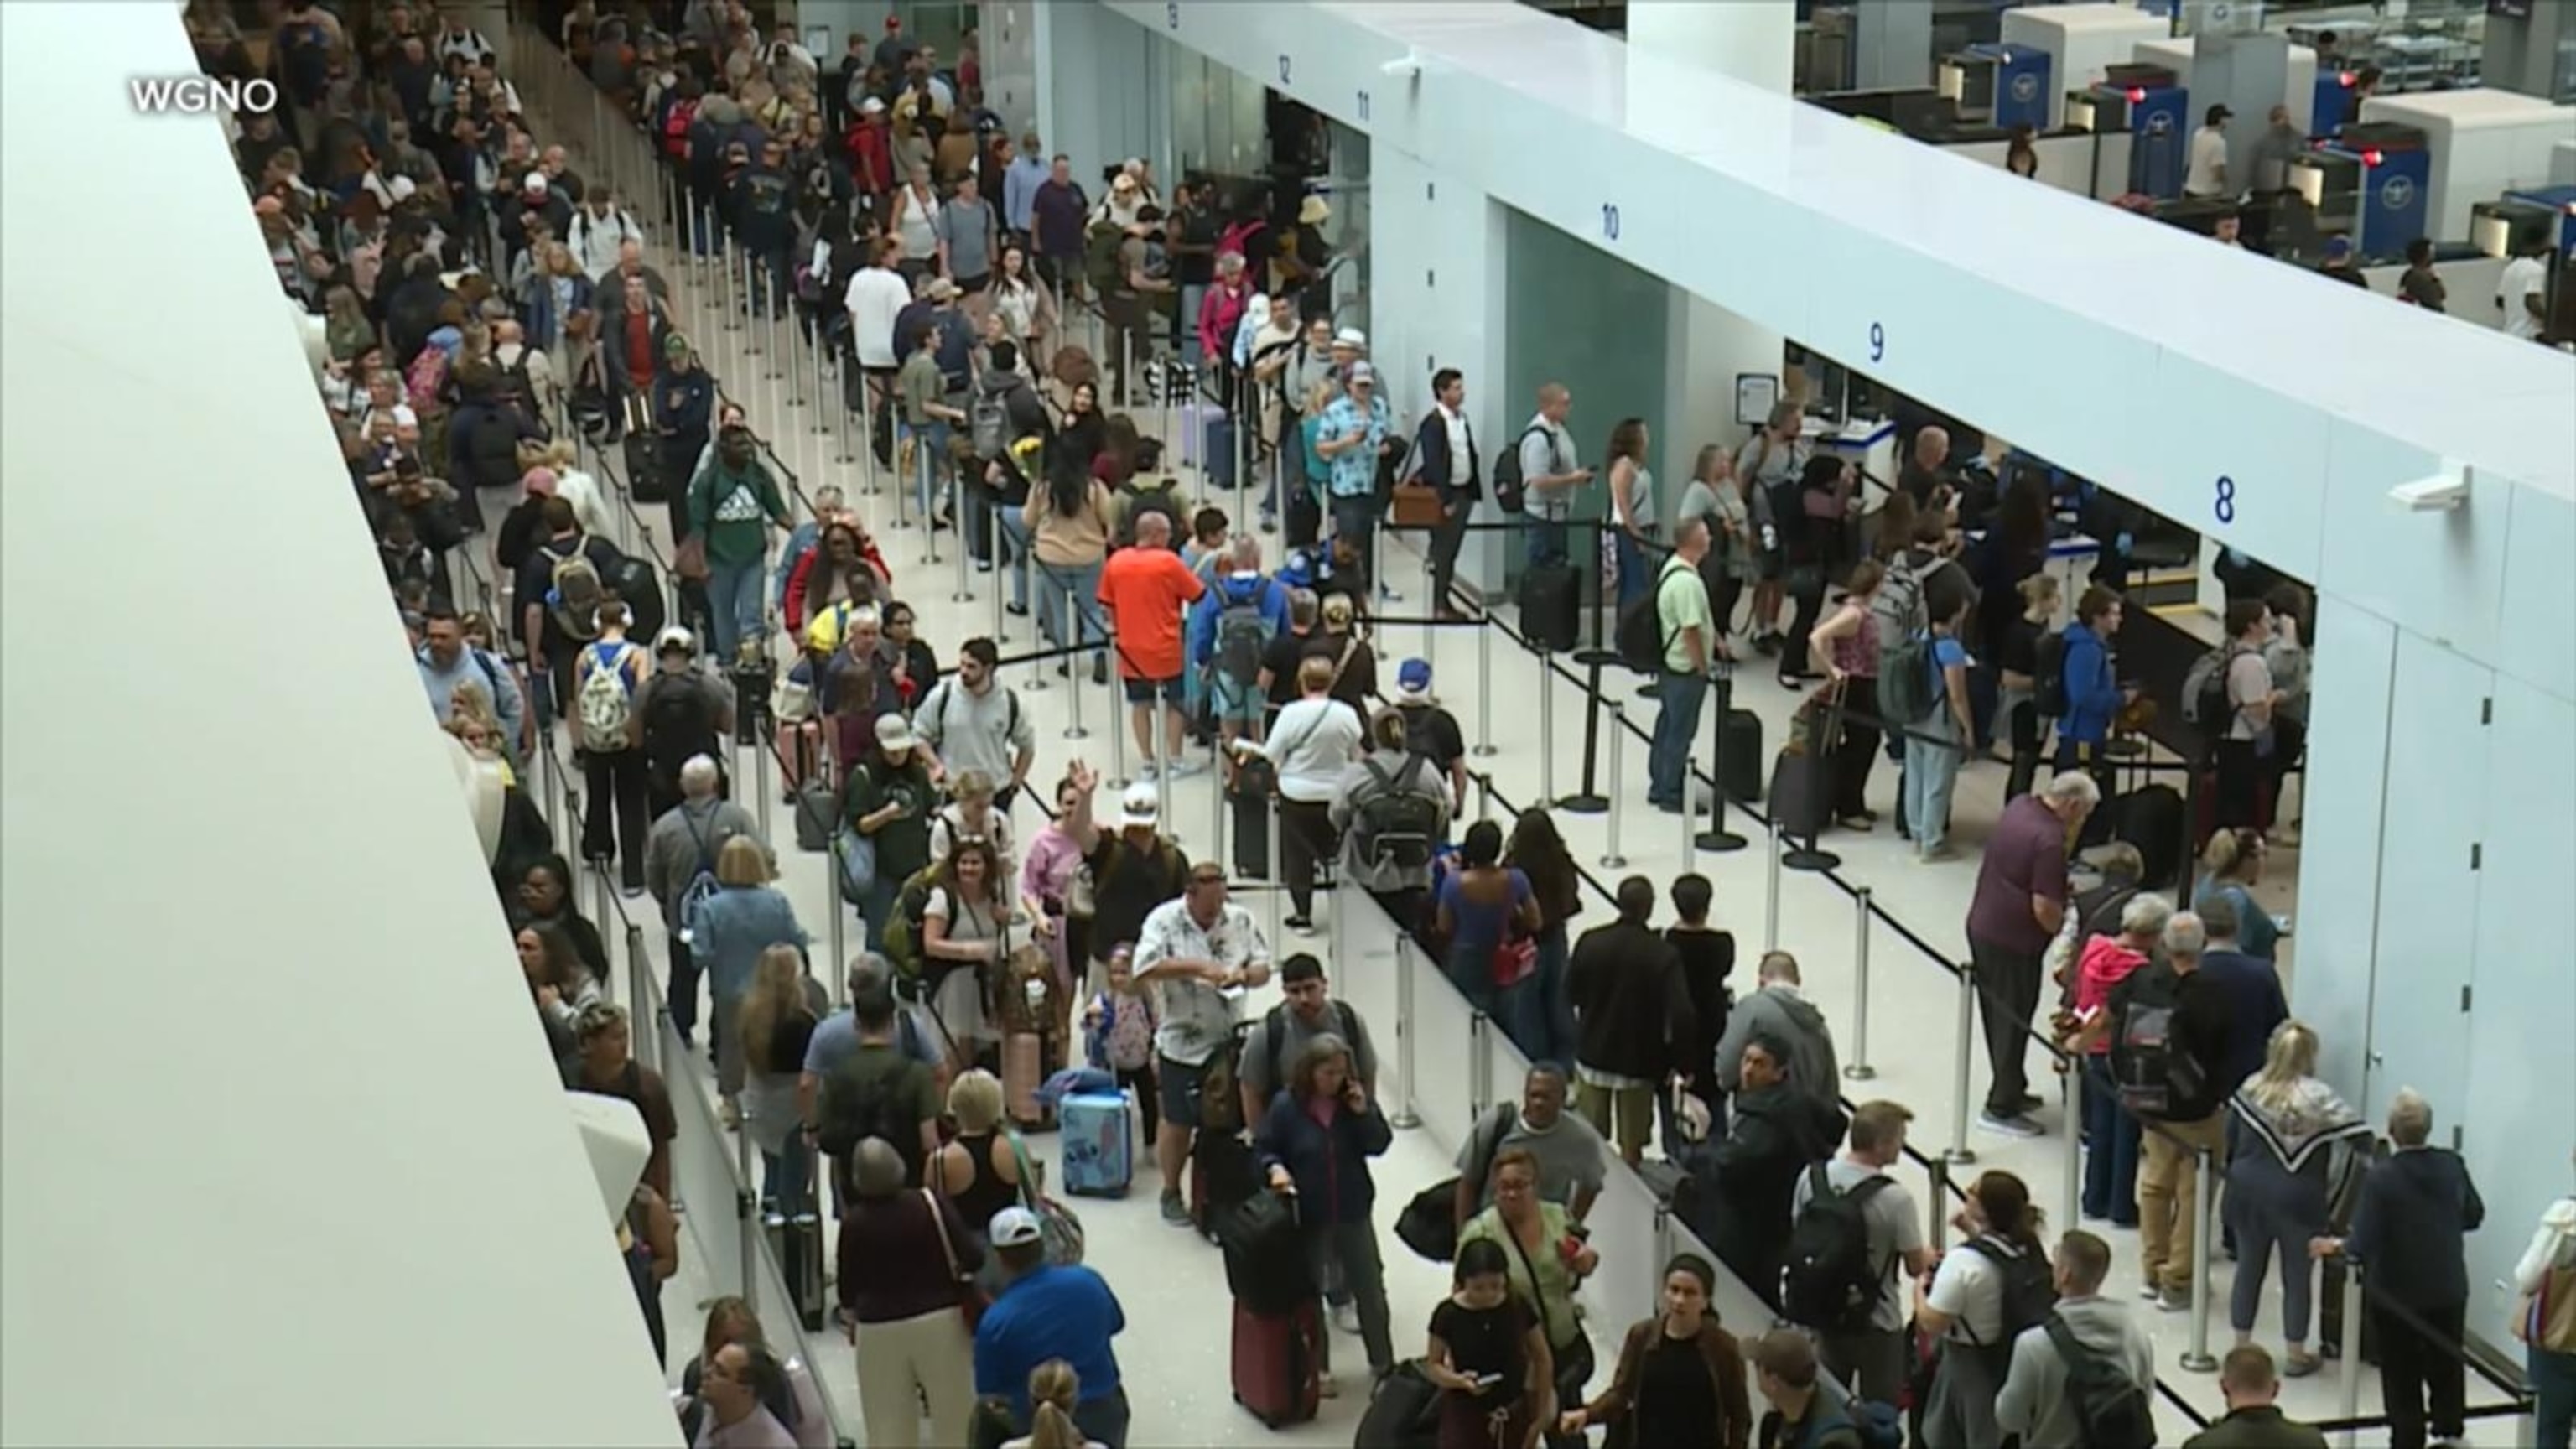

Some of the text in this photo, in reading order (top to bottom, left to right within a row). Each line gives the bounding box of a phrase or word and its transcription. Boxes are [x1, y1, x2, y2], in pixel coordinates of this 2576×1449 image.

[1358, 90, 1368, 121] 11
[1602, 203, 1619, 241] 10
[1870, 321, 1883, 362] 9
[2215, 475, 2234, 524] 8
